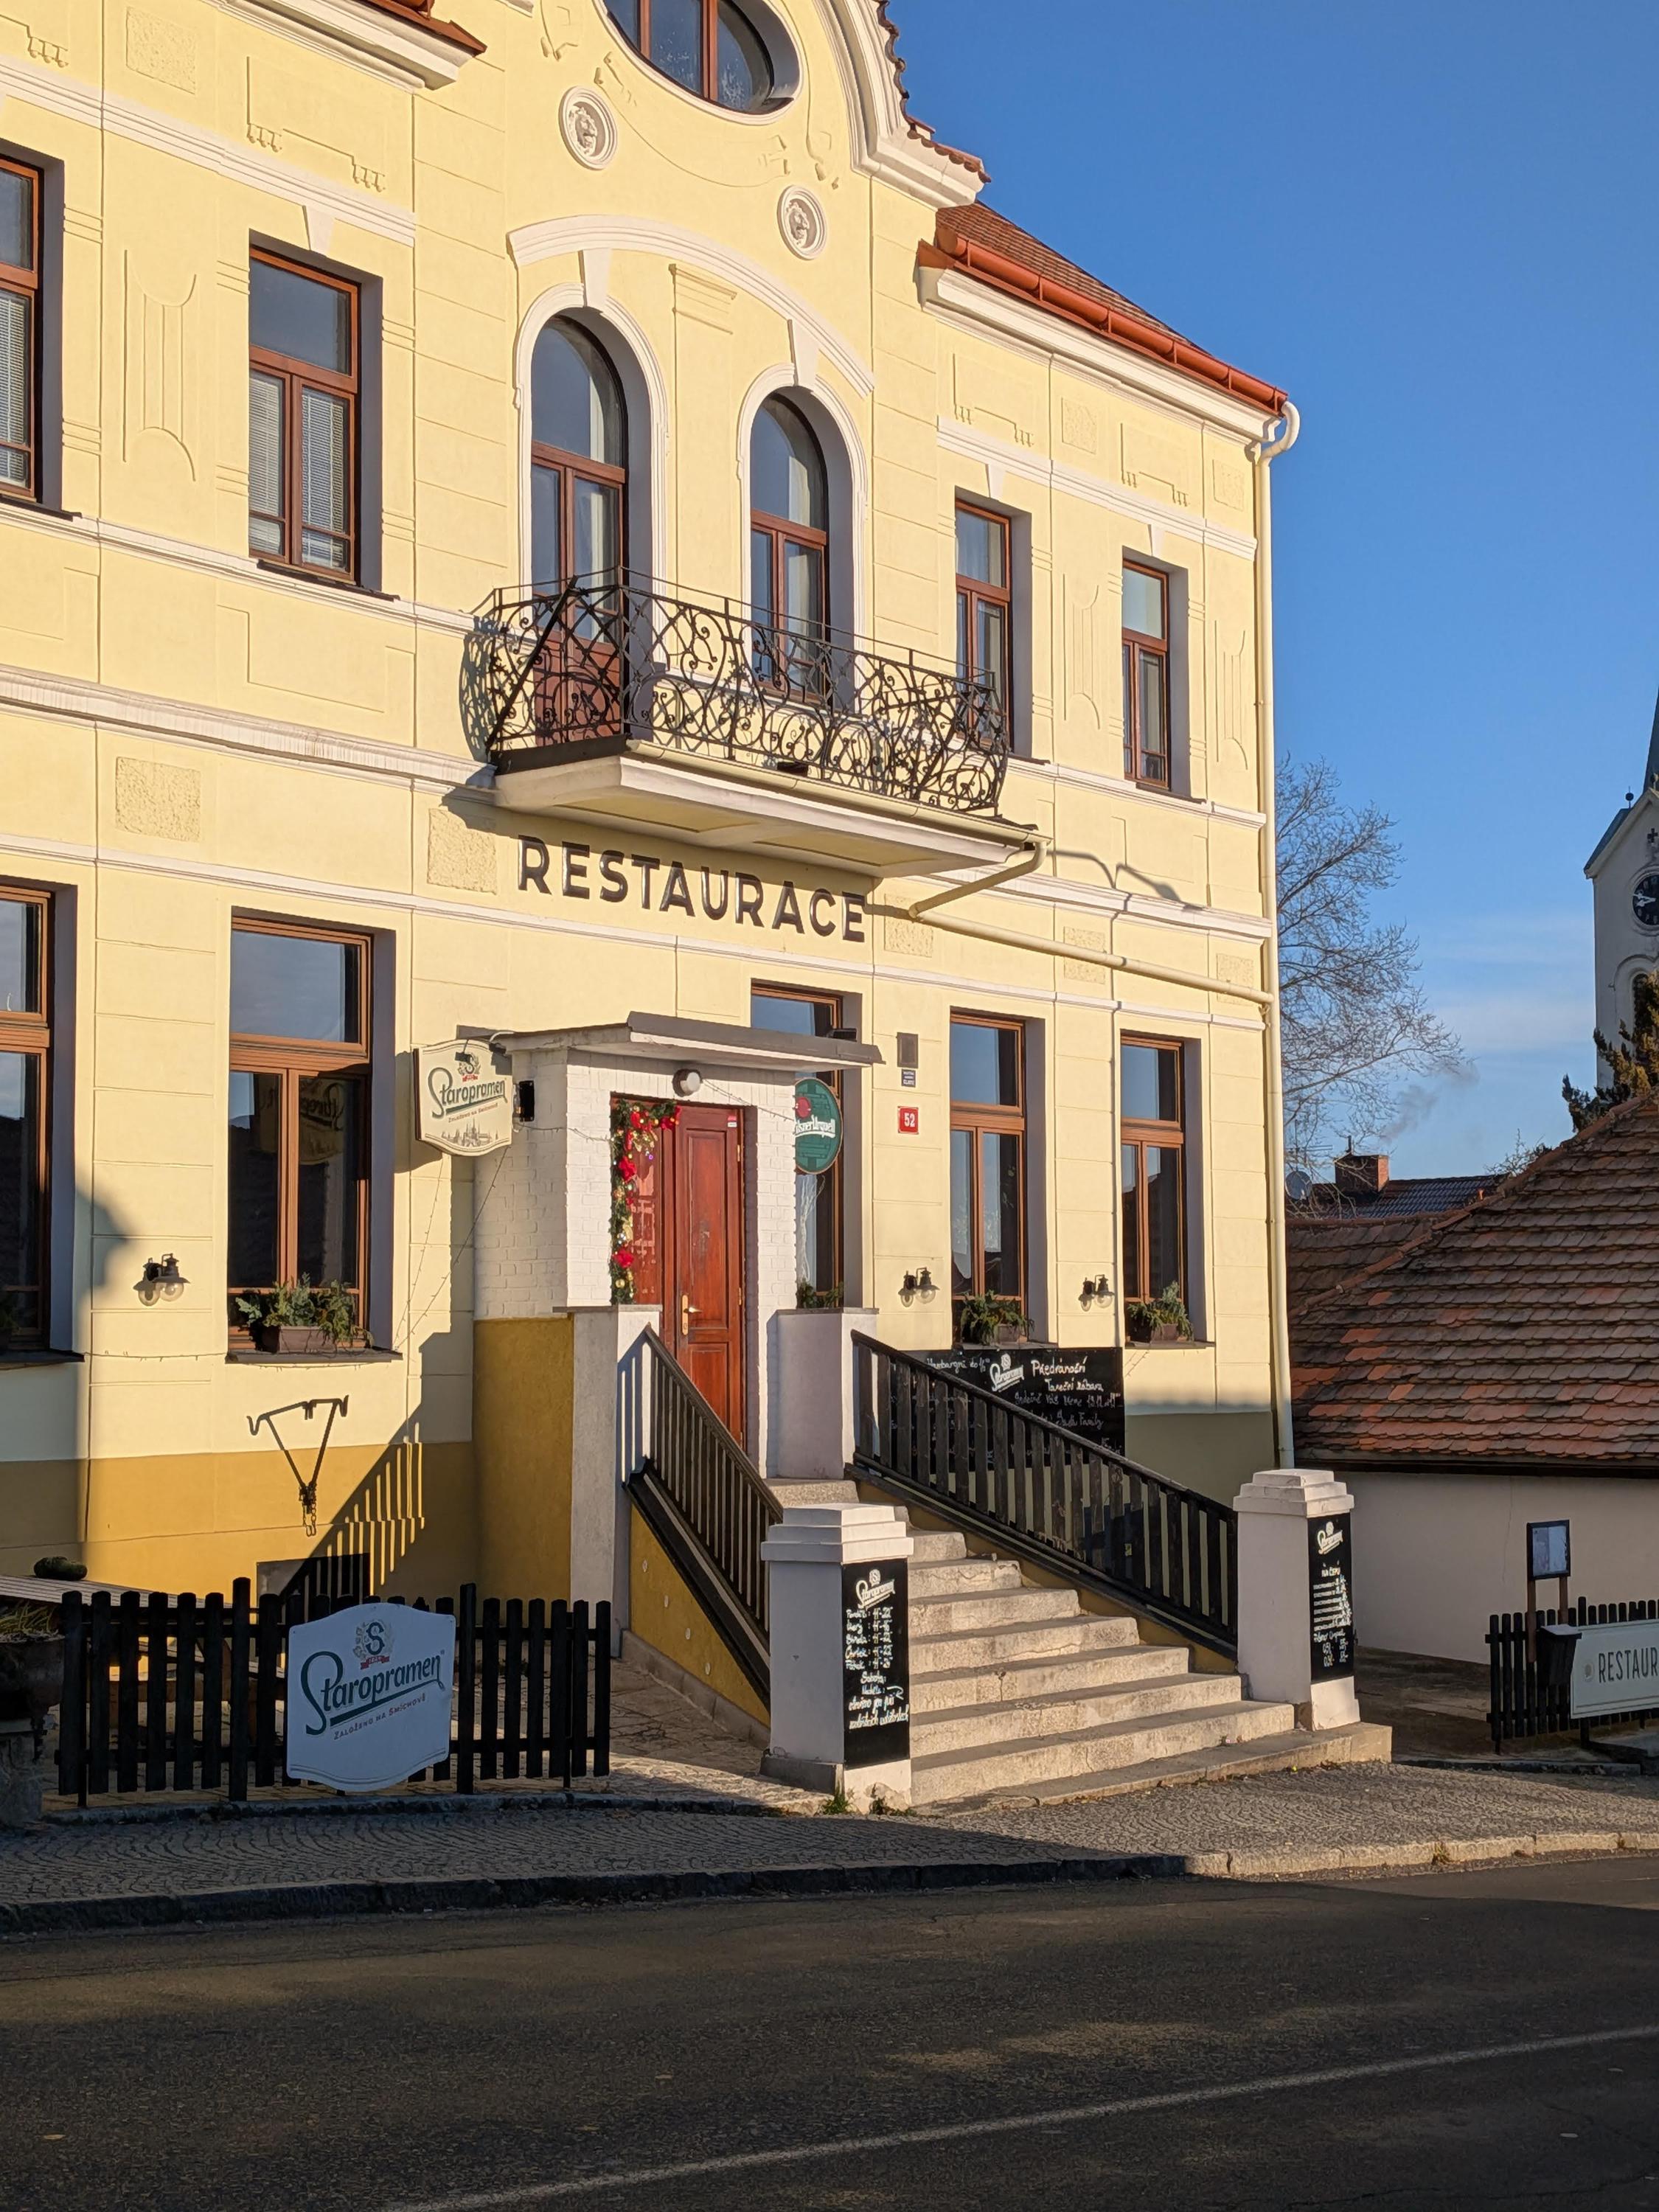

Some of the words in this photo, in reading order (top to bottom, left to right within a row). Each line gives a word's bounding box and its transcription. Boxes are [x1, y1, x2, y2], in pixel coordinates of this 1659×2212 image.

[518, 835, 866, 942] RESTAURACE
[428, 1067, 508, 1119] Staropramen
[904, 1112, 915, 1127] 52
[1599, 1646, 1658, 1683] RESTAUR
[300, 1651, 445, 1736] Staropramen
